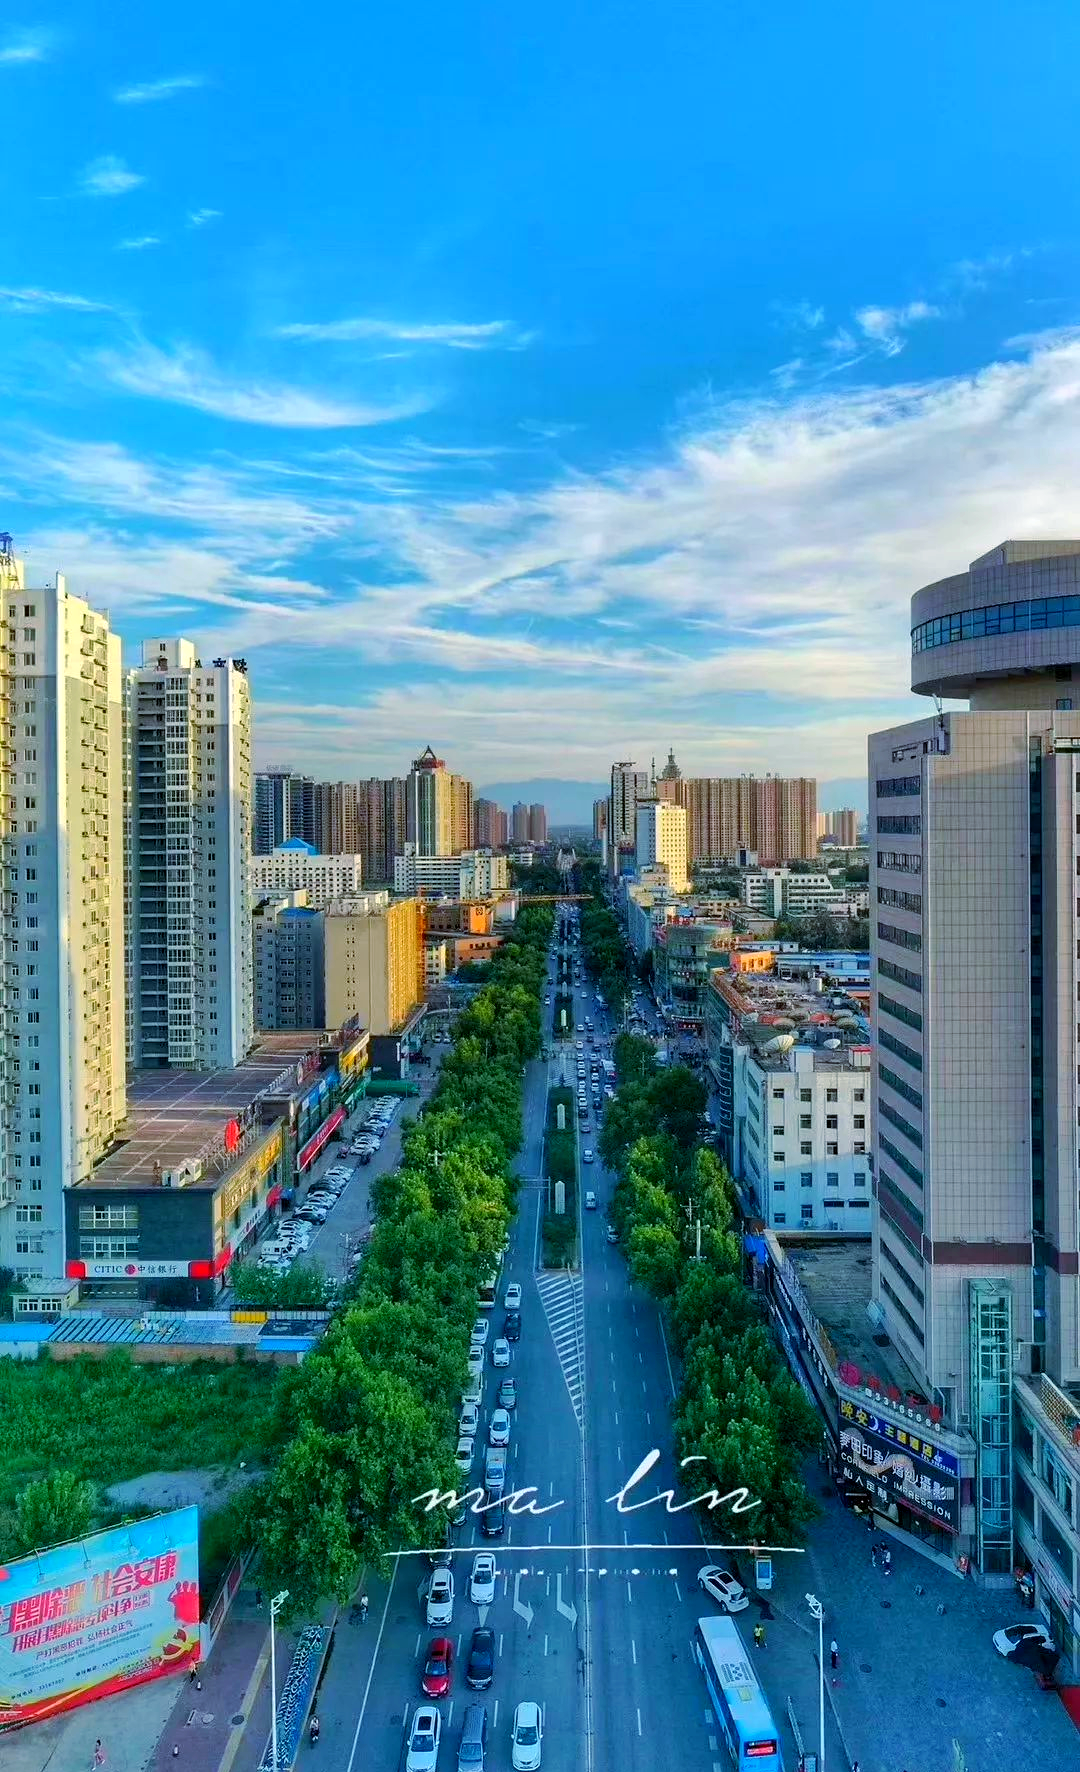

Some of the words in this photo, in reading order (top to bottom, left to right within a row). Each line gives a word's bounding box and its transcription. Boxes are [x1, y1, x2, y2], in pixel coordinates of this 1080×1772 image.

[94, 1265, 122, 1274] CITIC
[841, 1452, 888, 1484] CORLD
[893, 1481, 951, 1520] IMPRESSION
